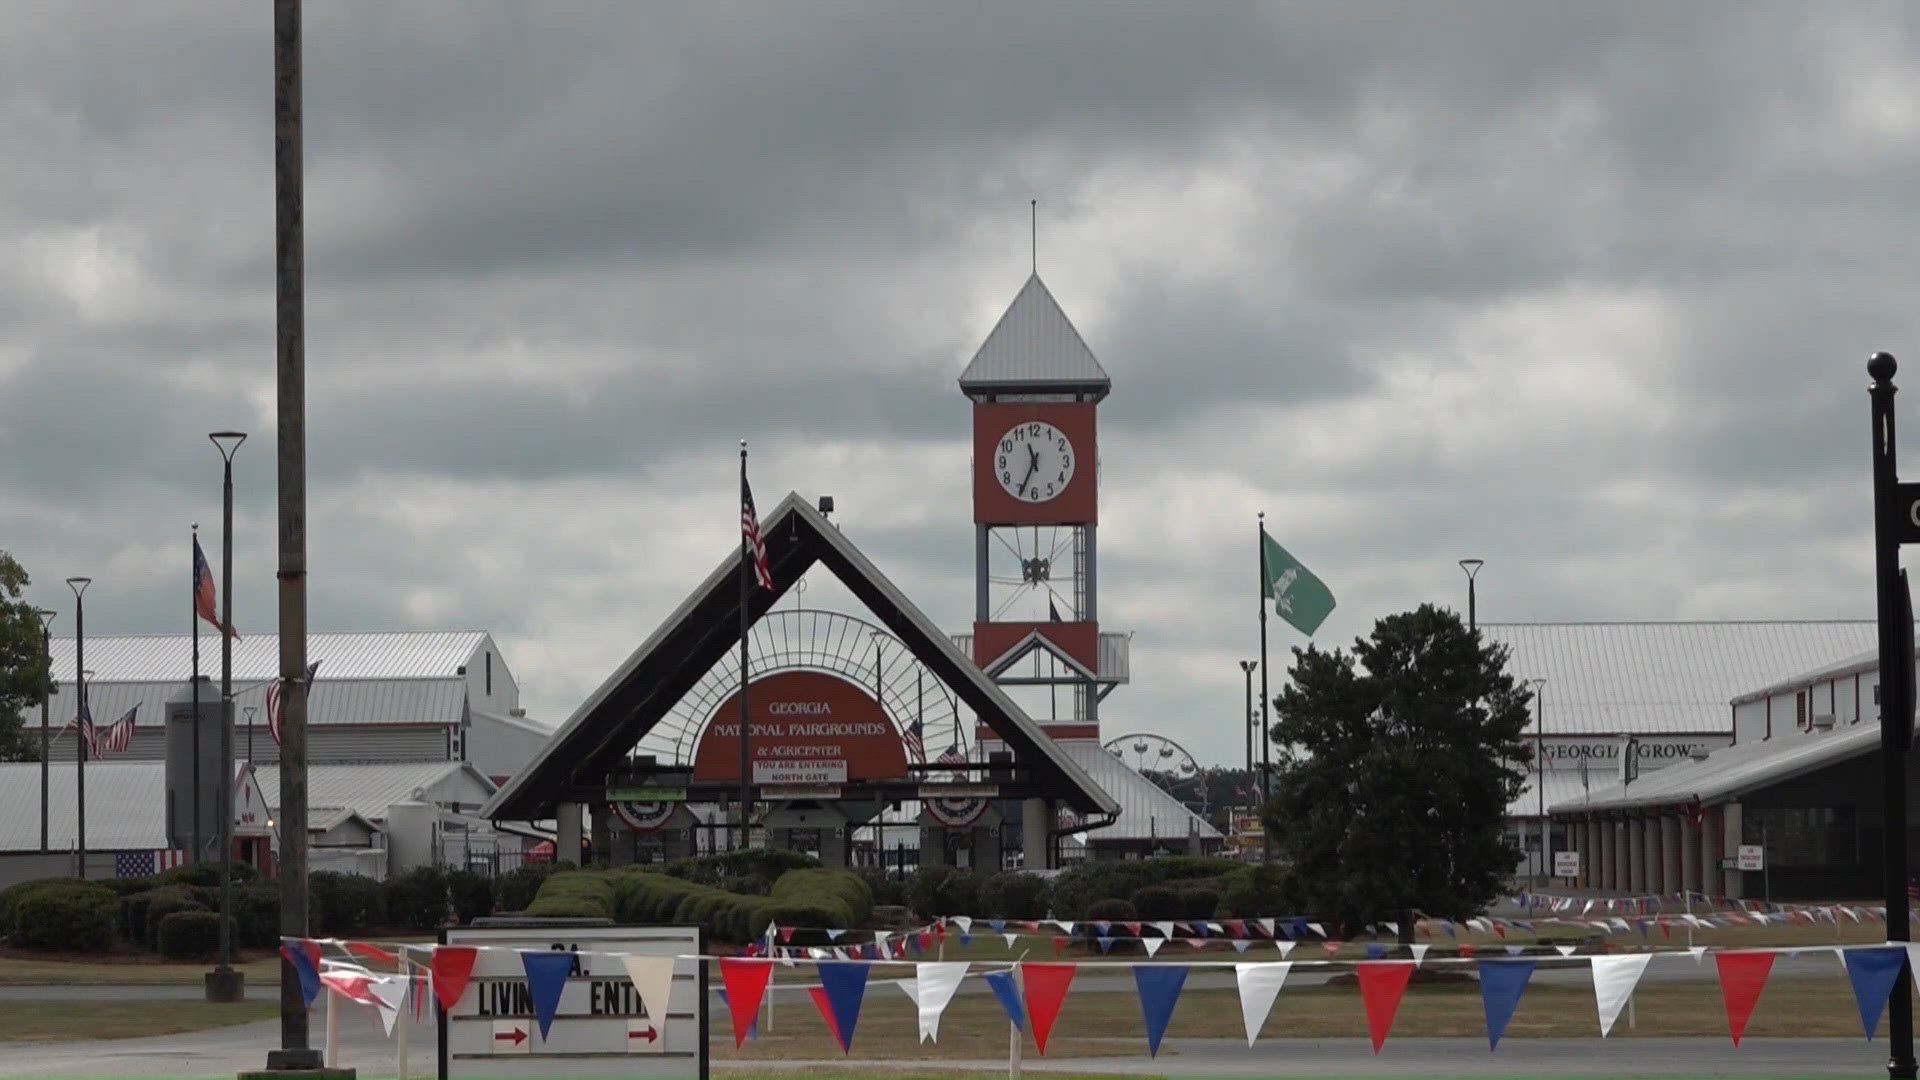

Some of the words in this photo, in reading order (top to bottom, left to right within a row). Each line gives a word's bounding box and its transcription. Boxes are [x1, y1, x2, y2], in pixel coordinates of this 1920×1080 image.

[1014, 428, 1024, 441] 11
[1028, 424, 1041, 437] 12
[1047, 428, 1052, 441] 1
[1000, 440, 1013, 453] 10
[1058, 438, 1066, 452] 2
[999, 456, 1007, 469] 9
[1062, 455, 1070, 469] 3
[1003, 471, 1010, 485] 8
[1058, 471, 1065, 484] 4
[1031, 487, 1039, 500] 6
[1046, 482, 1054, 496] 5
[768, 702, 831, 714] GEORGIA
[714, 723, 785, 737] NATONAL
[789, 723, 886, 736] FAIRGROUNDS
[757, 746, 768, 756] &
[770, 745, 842, 756] AGRICENTER
[1638, 744, 1704, 758] GROW
[757, 761, 777, 769] YOU
[778, 761, 796, 769] ARE
[798, 761, 843, 769] ENTERING
[772, 773, 803, 781] NORTH
[805, 773, 829, 781] GATE
[550, 943, 590, 977] A.
